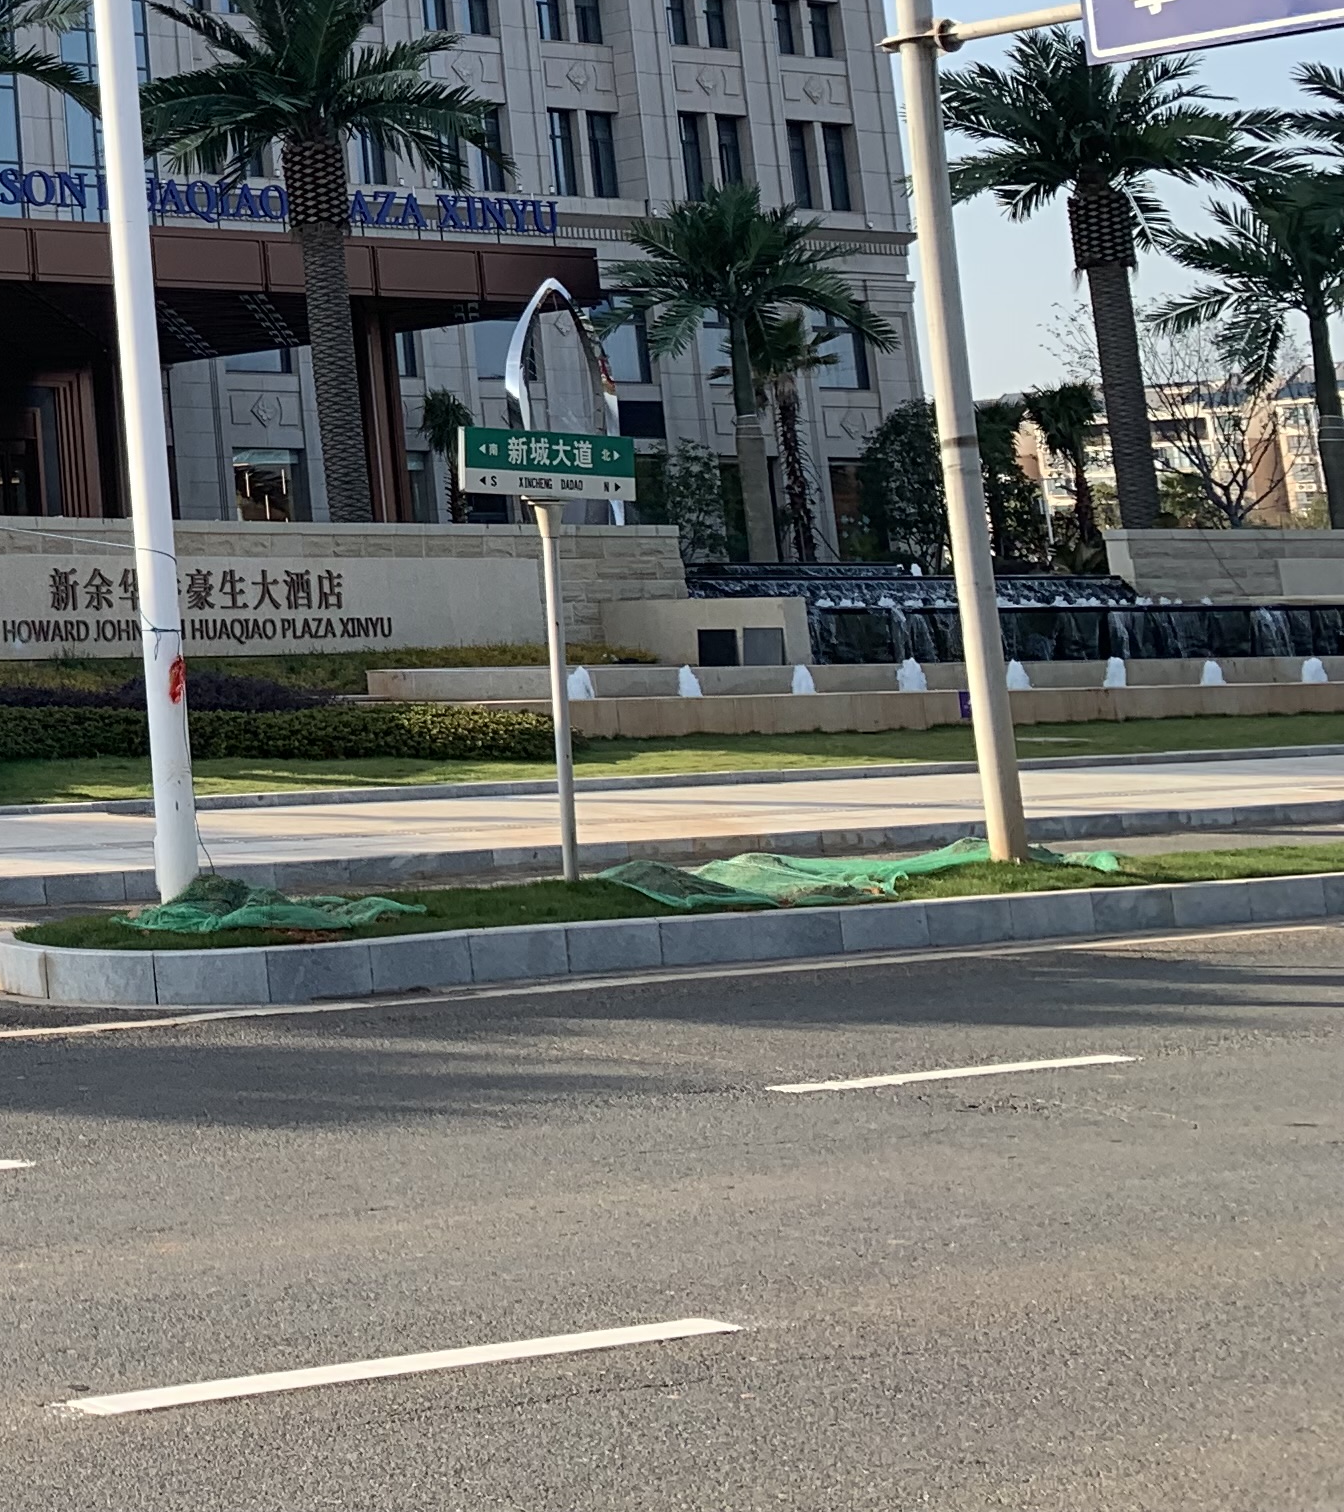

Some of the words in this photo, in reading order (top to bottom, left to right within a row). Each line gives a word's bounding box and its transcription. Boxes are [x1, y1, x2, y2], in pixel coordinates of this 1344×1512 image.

[349, 190, 428, 229] AZA
[435, 194, 558, 234] XINYU
[488, 443, 499, 457] 南
[507, 436, 594, 469] 新城大道
[601, 448, 612, 462] 北
[490, 475, 498, 487] S
[518, 476, 553, 490] XINCHENG
[560, 478, 584, 491] DADAO
[603, 481, 610, 493] N
[49, 568, 343, 612] 新余华豪生大酒店
[2, 618, 89, 643] HOWARD
[94, 618, 186, 643] JOHN
[191, 618, 277, 644] HUAQIAO
[281, 618, 336, 639] PLAZA
[339, 616, 392, 639] XINYU
